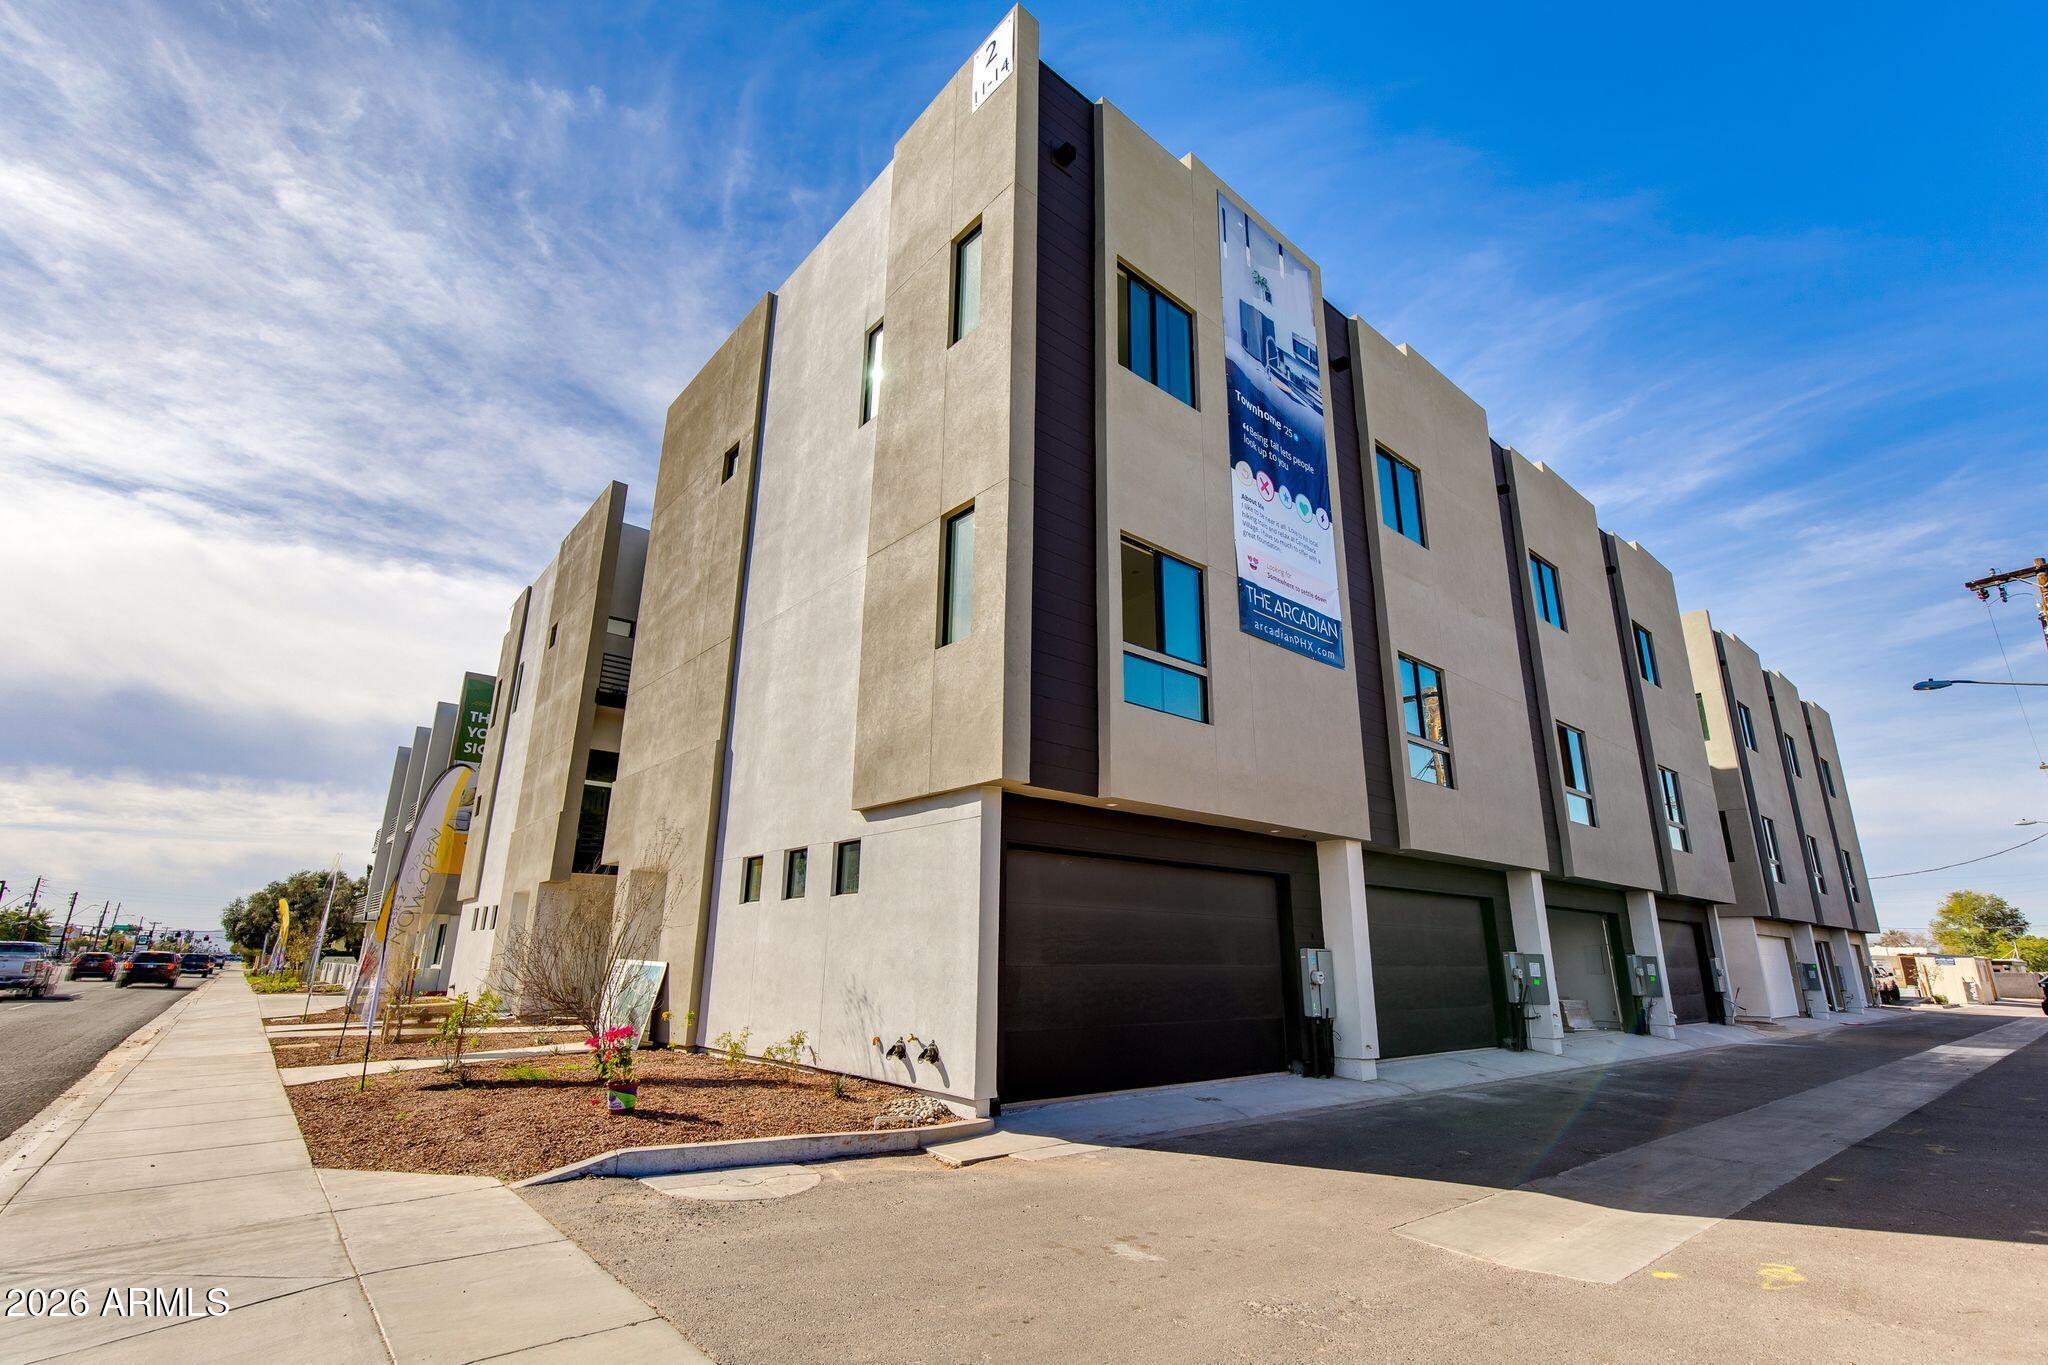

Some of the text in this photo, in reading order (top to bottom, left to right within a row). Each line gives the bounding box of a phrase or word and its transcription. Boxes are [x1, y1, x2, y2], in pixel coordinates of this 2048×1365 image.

[985, 39, 998, 68] 2
[1234, 389, 1282, 430] Townhome
[1243, 433, 1289, 471] look up to you
[1270, 440, 1280, 453] tall
[1280, 445, 1292, 461] lets
[1293, 456, 1315, 474] people
[1241, 494, 1257, 507] About
[1242, 511, 1257, 525] hiking
[1242, 530, 1256, 541] great
[1266, 563, 1285, 578] Looking
[1267, 572, 1295, 591] Somewhere
[1245, 585, 1339, 639] THE ARCADIAN
[1254, 620, 1335, 660] arcadianPHX.com
[389, 886, 426, 945] NOW
[419, 828, 442, 885] OPEN
